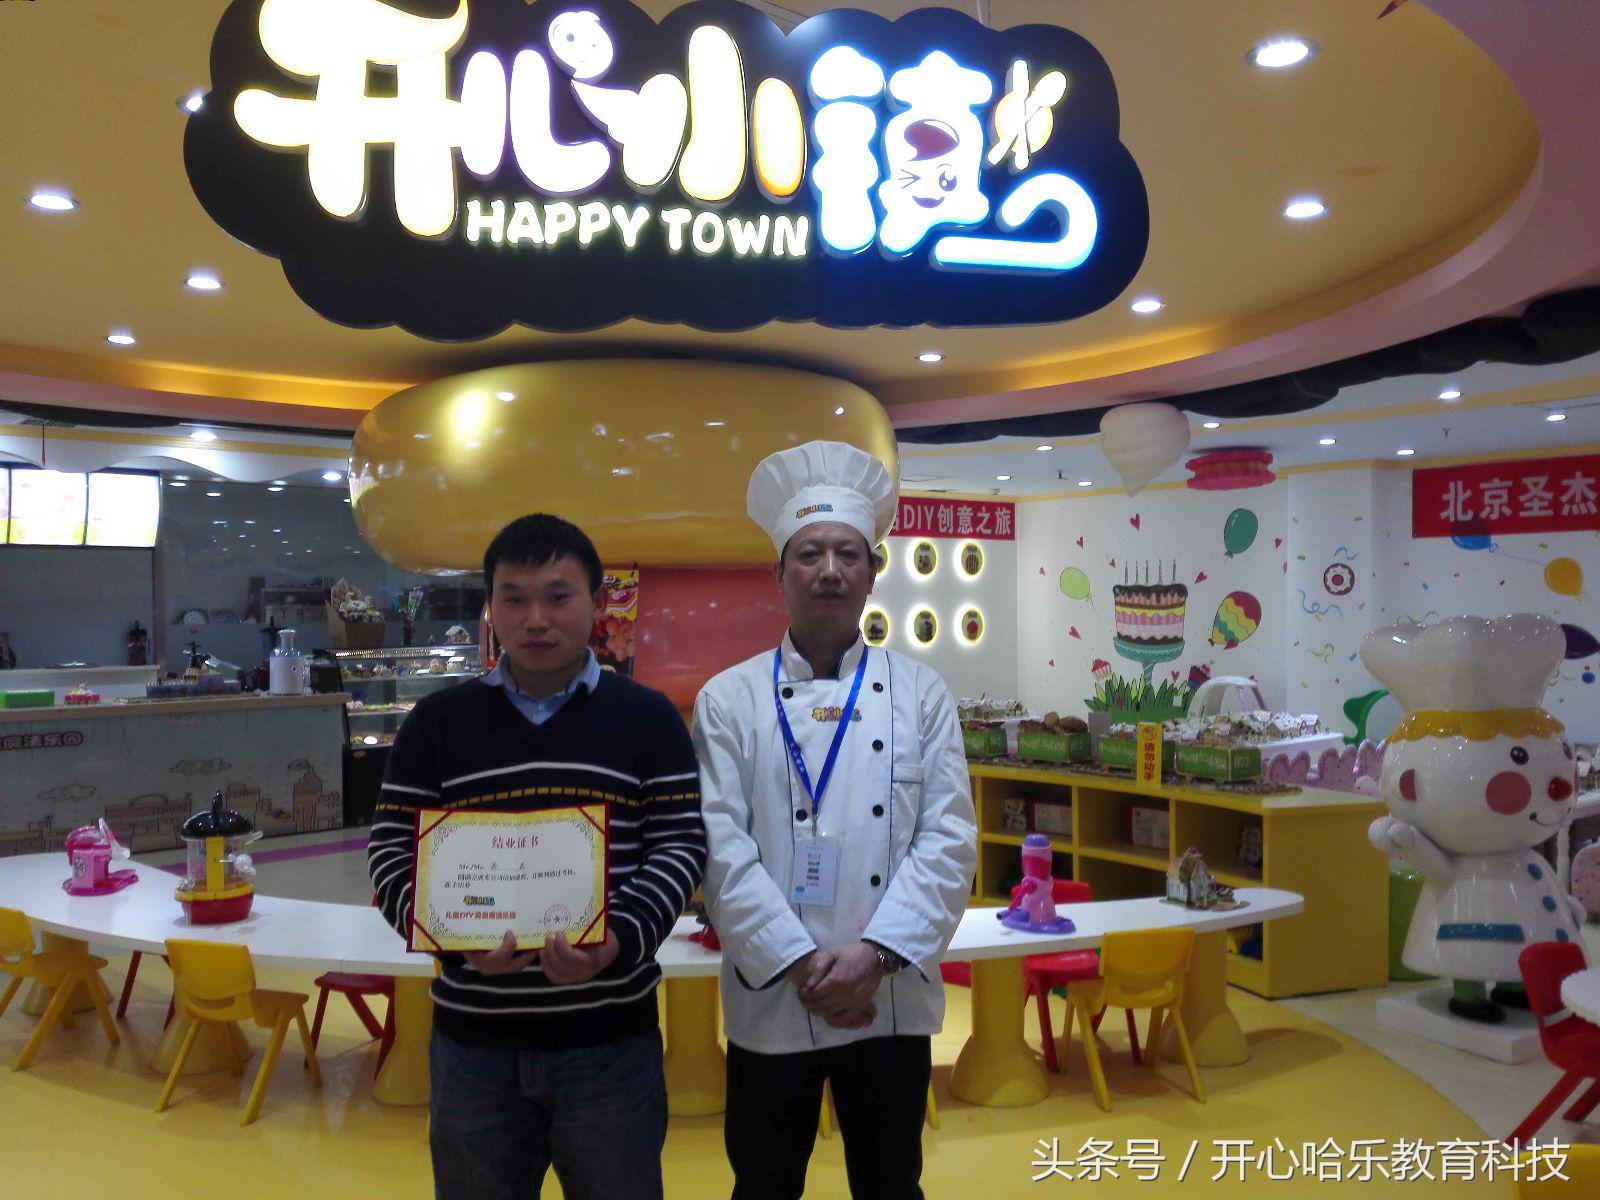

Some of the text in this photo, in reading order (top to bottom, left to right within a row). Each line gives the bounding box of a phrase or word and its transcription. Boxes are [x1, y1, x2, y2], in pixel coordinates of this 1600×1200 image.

[465, 199, 809, 257] HAPPY TOWN
[1440, 471, 1598, 522] 北京圣杰
